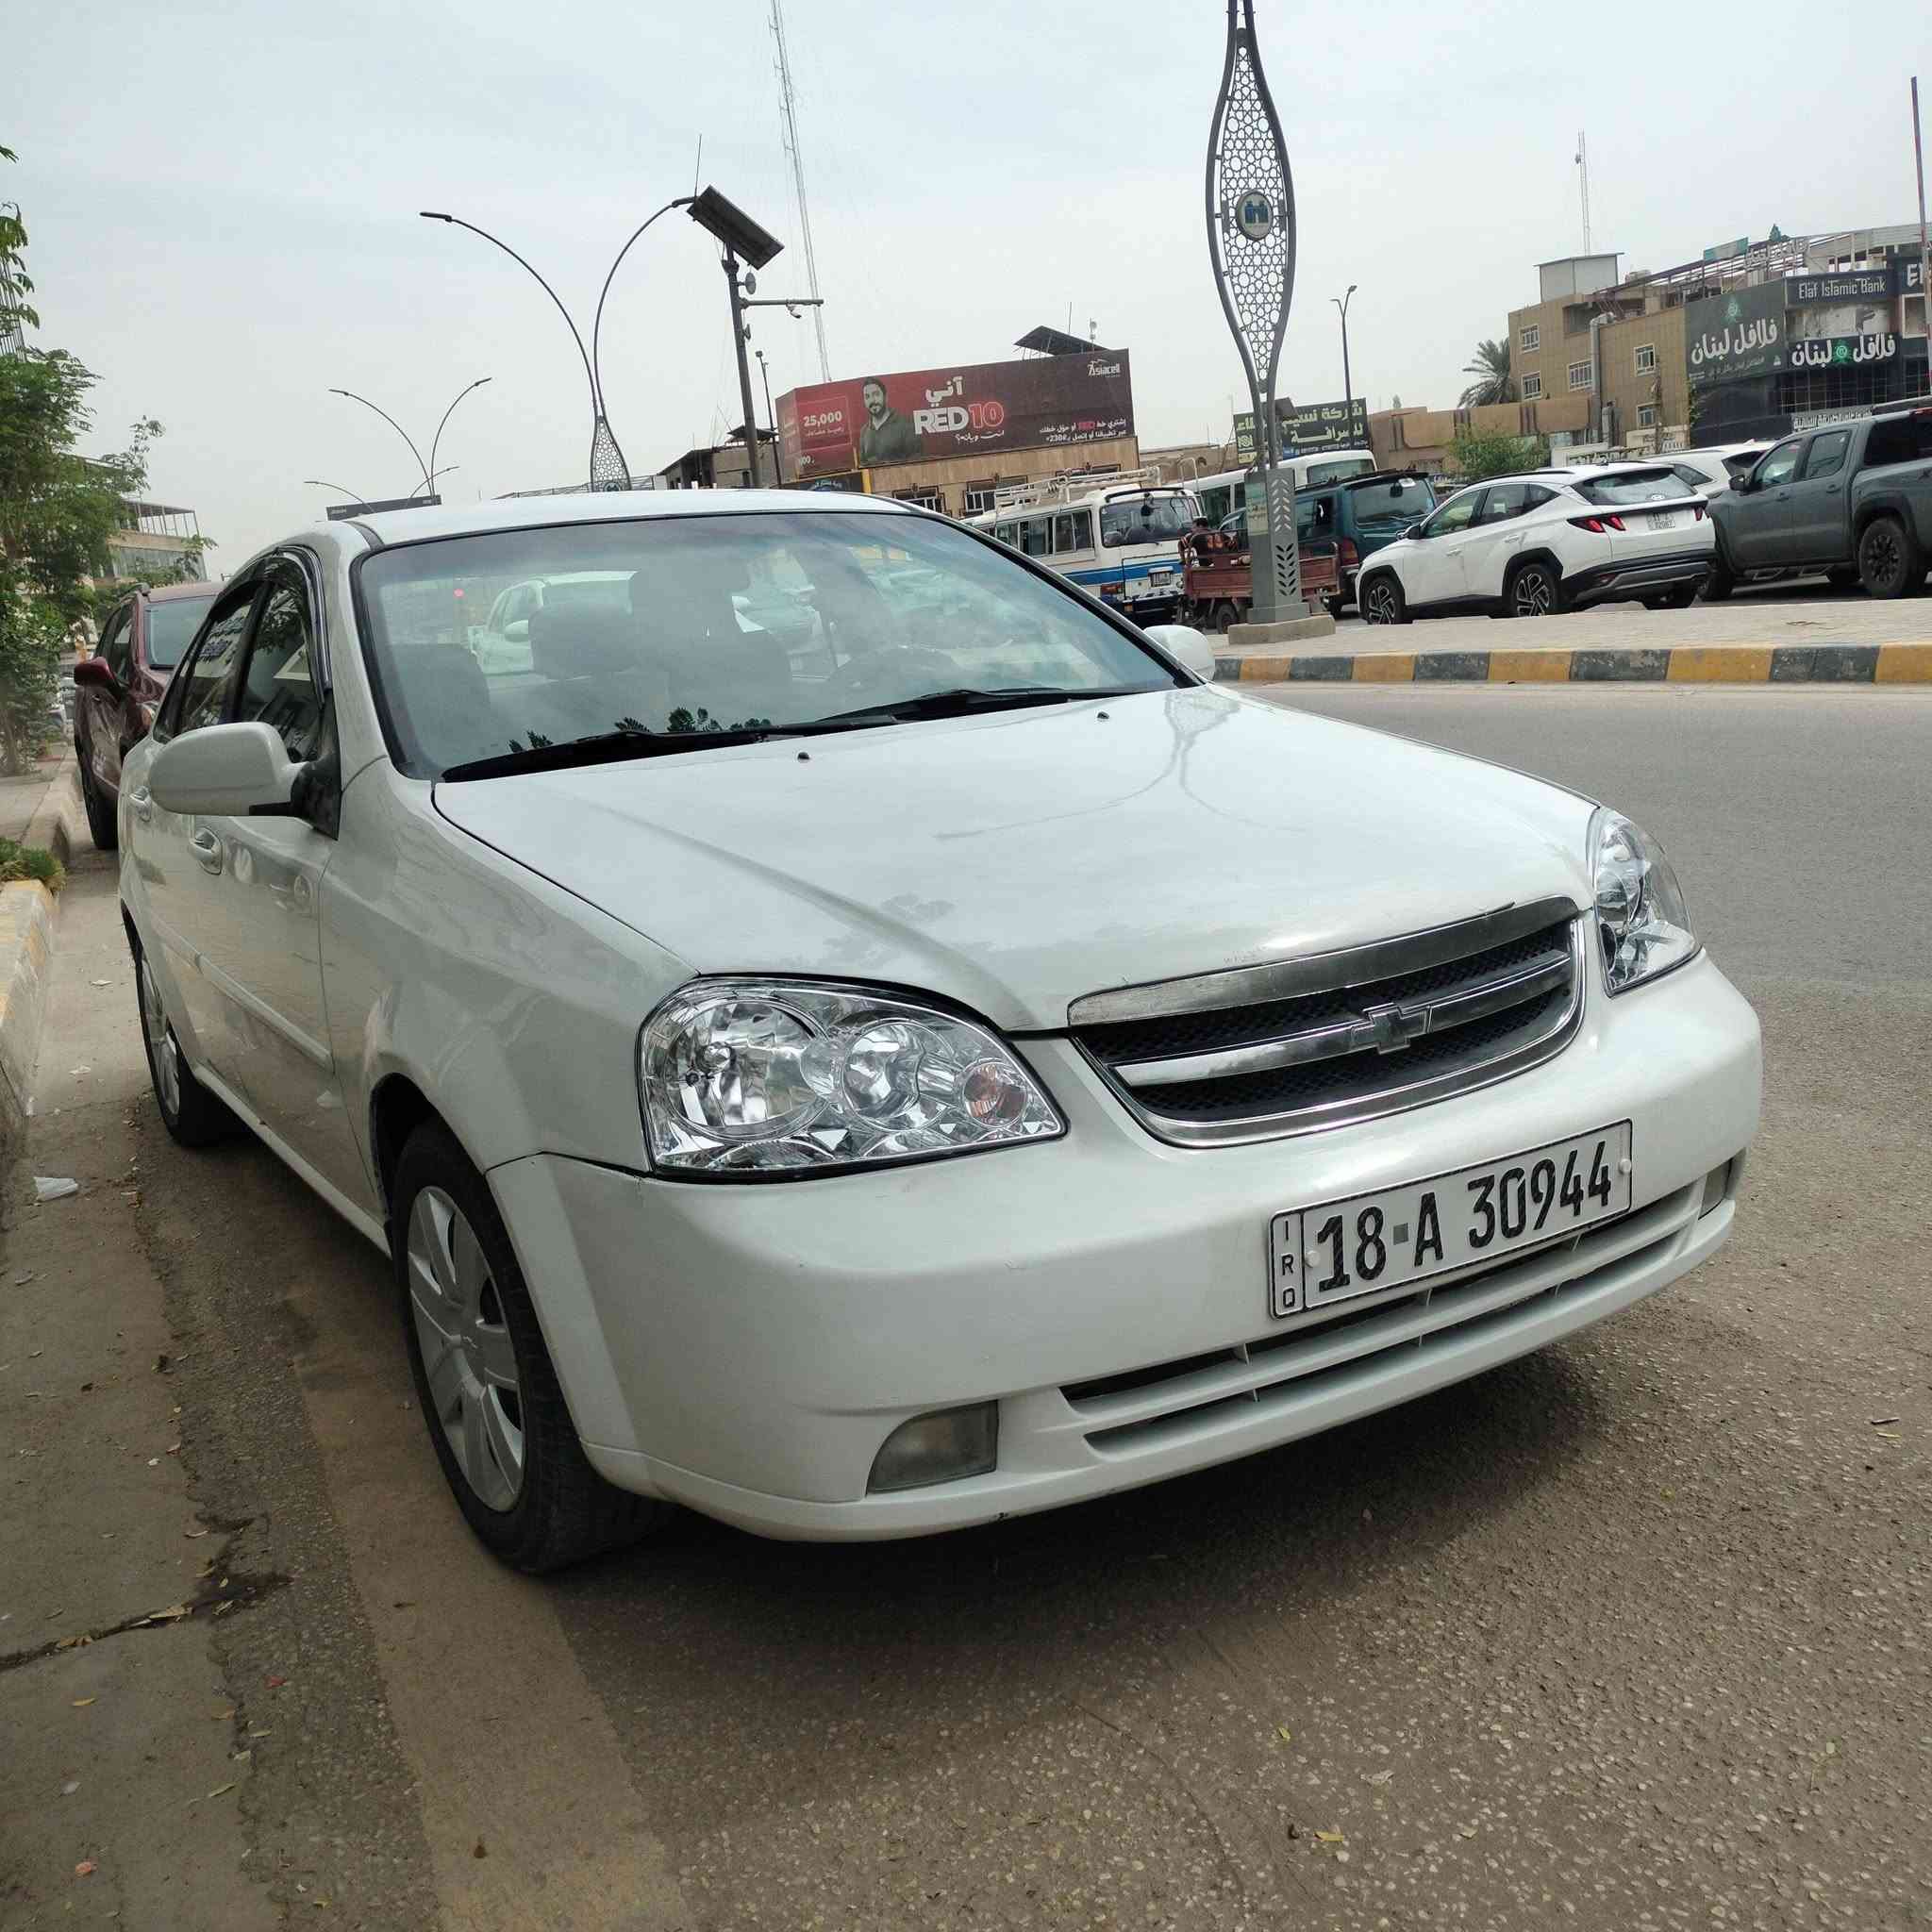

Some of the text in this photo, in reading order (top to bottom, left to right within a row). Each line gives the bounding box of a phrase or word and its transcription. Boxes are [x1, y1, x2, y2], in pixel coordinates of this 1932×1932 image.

[1798, 275, 1886, 299] Elaf Islamic Bank
[1690, 317, 1778, 365] فلافل لبنان
[1790, 339, 1833, 369] لبنان
[1852, 332, 1896, 362] فلافل
[925, 375, 963, 408] آني
[803, 410, 842, 427] 25,000
[1467, 1141, 1612, 1249] 30944
